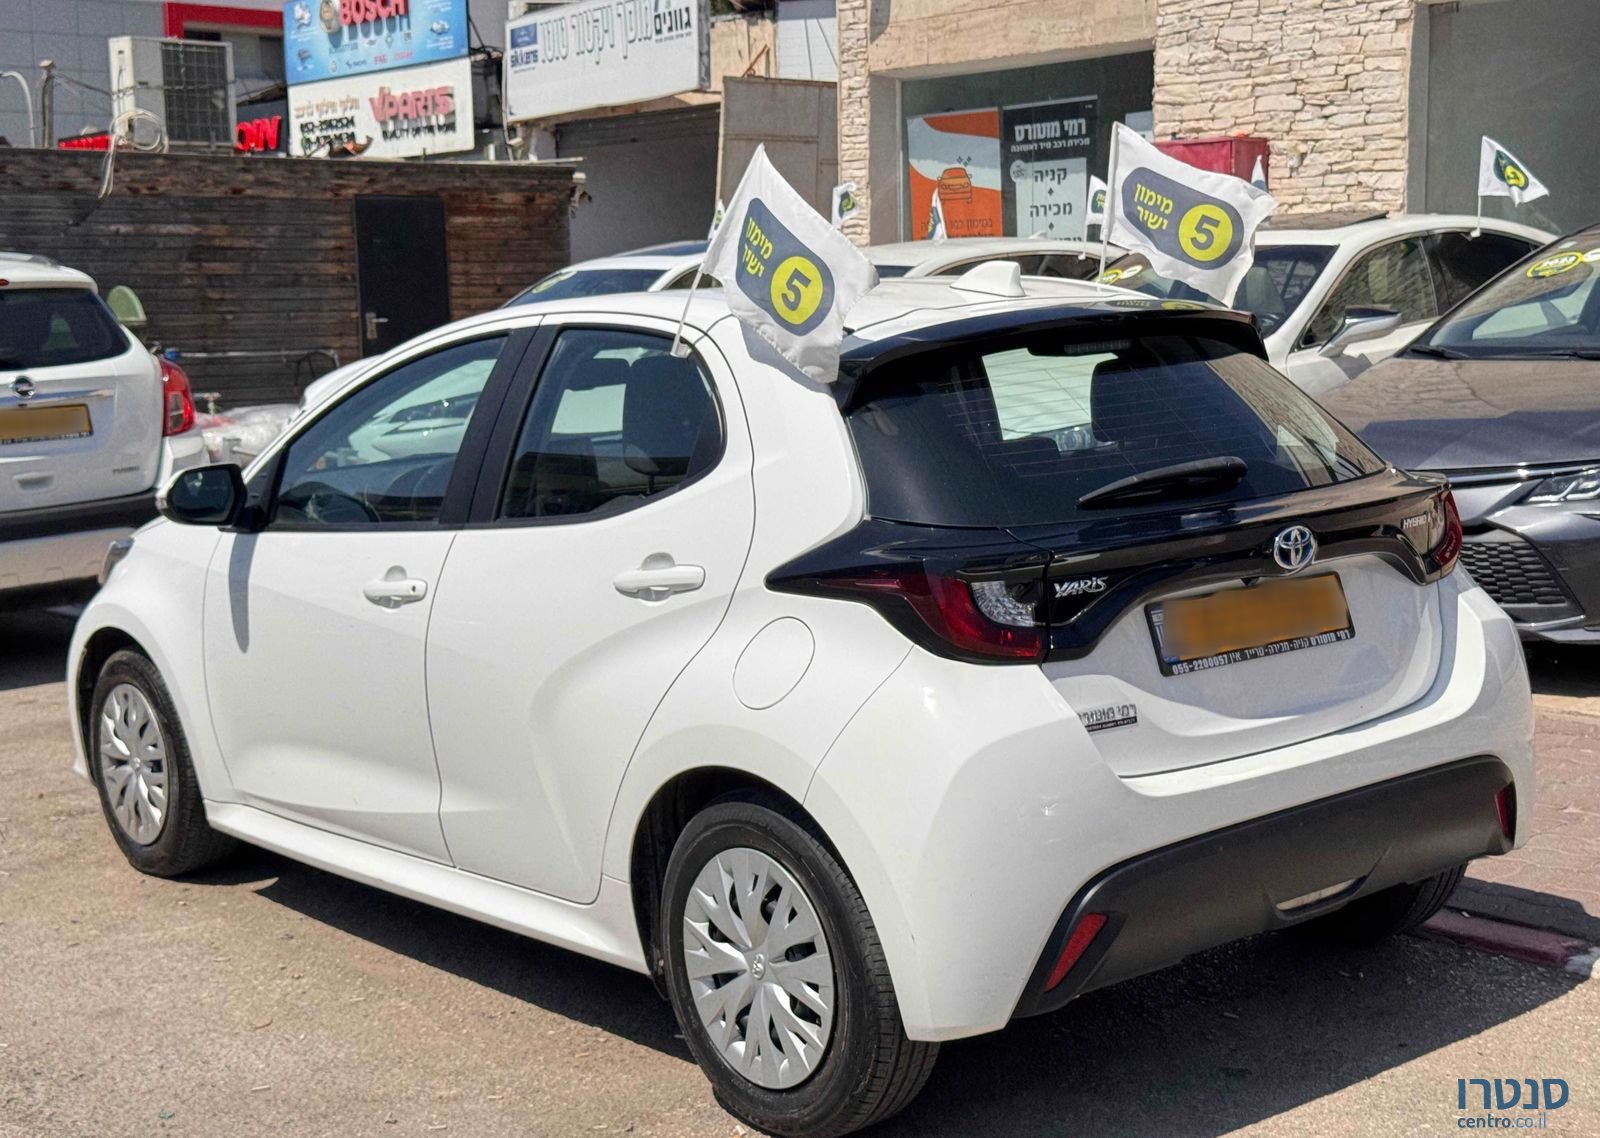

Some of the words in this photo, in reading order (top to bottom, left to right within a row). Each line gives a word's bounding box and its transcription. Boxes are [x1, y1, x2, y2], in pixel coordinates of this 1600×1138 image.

[340, 0, 408, 26] BOSCH
[654, 6, 692, 36] גוונים
[571, 5, 614, 65] ויקטור
[1014, 120, 1060, 142] מוטורס
[1063, 118, 1086, 136] רמי
[1011, 143, 1038, 152] ראשונה
[1040, 141, 1052, 150] מיד
[1053, 139, 1067, 148] רכב
[1068, 137, 1090, 148] מכירת
[1034, 167, 1067, 185] קניה
[1134, 183, 1173, 215] מימון
[1029, 201, 1073, 218] מכירה
[1136, 206, 1169, 231] ישיר
[746, 218, 773, 260] מימון
[1190, 214, 1221, 251] 5
[742, 243, 764, 278] ישיר
[781, 268, 812, 312] 5
[1403, 513, 1427, 529] HYBRID
[1310, 632, 1336, 647] מוטורס
[1336, 629, 1351, 640] רמי
[1172, 654, 1229, 675] 055-2200057
[1115, 703, 1137, 718] רמי
